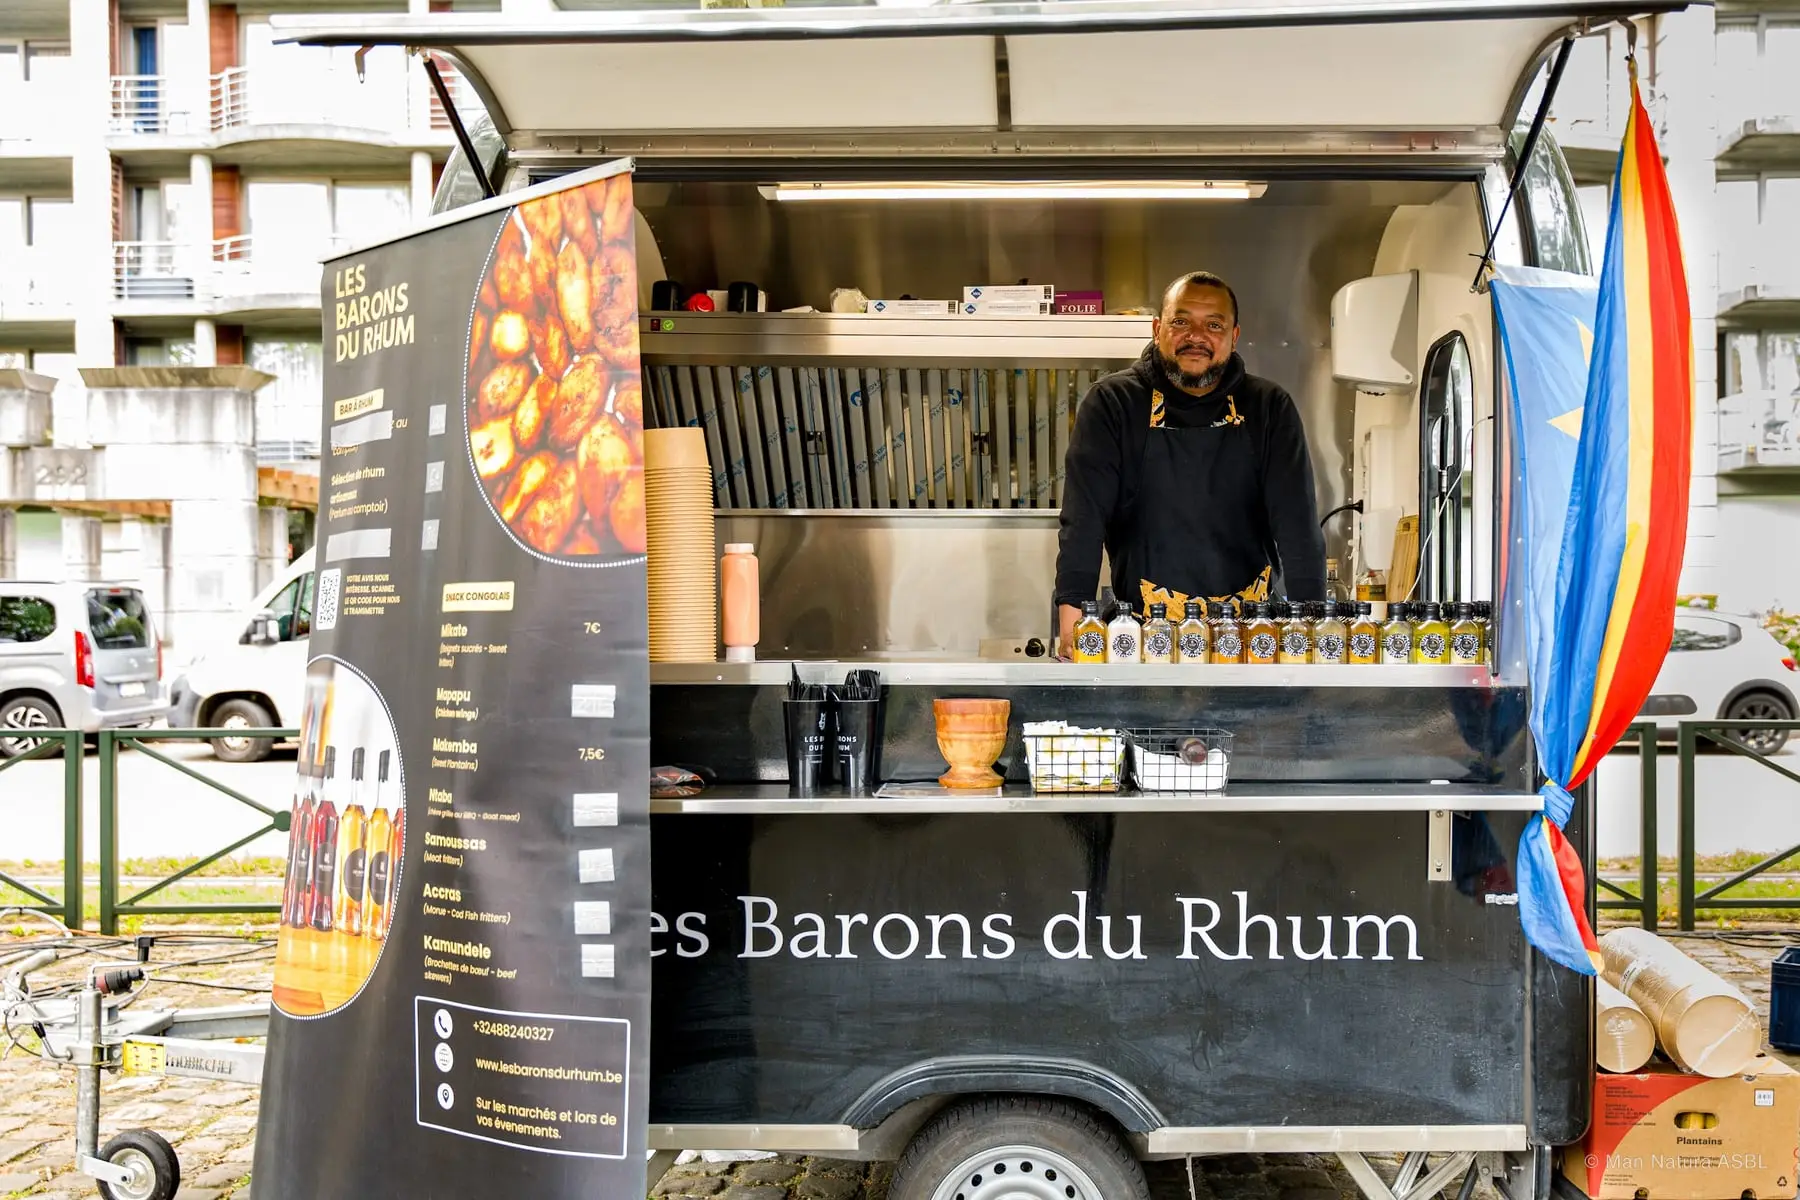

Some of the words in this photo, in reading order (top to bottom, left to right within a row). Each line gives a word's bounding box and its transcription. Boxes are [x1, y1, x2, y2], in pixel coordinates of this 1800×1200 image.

[335, 264, 366, 299] LES
[335, 282, 409, 331] BARONS
[1061, 304, 1097, 313] FOLIE
[335, 329, 360, 363] DU
[363, 314, 415, 355] RHUM
[339, 403, 353, 416] BAR
[358, 395, 374, 410] RHUM
[395, 418, 408, 429] au
[362, 467, 385, 479] rhum
[353, 498, 388, 517] comptoir)
[346, 574, 361, 583] VOTRE
[361, 574, 374, 582] AVIS
[374, 574, 390, 582] NOUS
[371, 585, 395, 593] SCANNEZ
[445, 592, 465, 602] SNACK
[465, 591, 511, 602] CONGOLAIS
[349, 596, 357, 605] QR
[357, 596, 372, 604] CODE
[372, 596, 387, 604] POUR
[387, 595, 401, 604] NOUS
[440, 622, 468, 639] Mikate
[583, 622, 601, 634] 7€
[488, 643, 508, 654] Sweet
[436, 687, 471, 705] Mapapu
[432, 737, 478, 754] Makemba
[804, 735, 818, 743] LES
[578, 747, 605, 762] 7,5€
[428, 788, 453, 804] Ntaba
[424, 831, 487, 851] Samoussas
[423, 850, 441, 863] (Meat
[442, 854, 463, 868] fritters)
[422, 883, 462, 902] Accras
[423, 902, 446, 916] (Morue
[451, 908, 464, 919] Cod
[464, 911, 479, 921] Fish
[479, 911, 511, 925] fritters)
[650, 911, 710, 958] es
[737, 895, 1016, 960] Barons
[1043, 890, 1148, 960] du
[1176, 890, 1423, 960] Rhum
[423, 935, 492, 960] Kamundele
[424, 955, 460, 971] (Brochettes
[460, 963, 469, 974] de
[496, 967, 517, 979] beef
[424, 970, 452, 985] skewers)
[473, 1020, 554, 1041] +32488240327
[475, 1057, 623, 1084] www.lesbaronsdurhum.be
[475, 1096, 491, 1110] Sur
[492, 1099, 507, 1114] les
[508, 1104, 557, 1121] marchés
[559, 1109, 572, 1123] et
[574, 1109, 597, 1125] lors
[600, 1110, 617, 1126] de
[476, 1115, 493, 1128] vos
[494, 1114, 562, 1139] évenements.
[1676, 1136, 1723, 1146] Plantains
